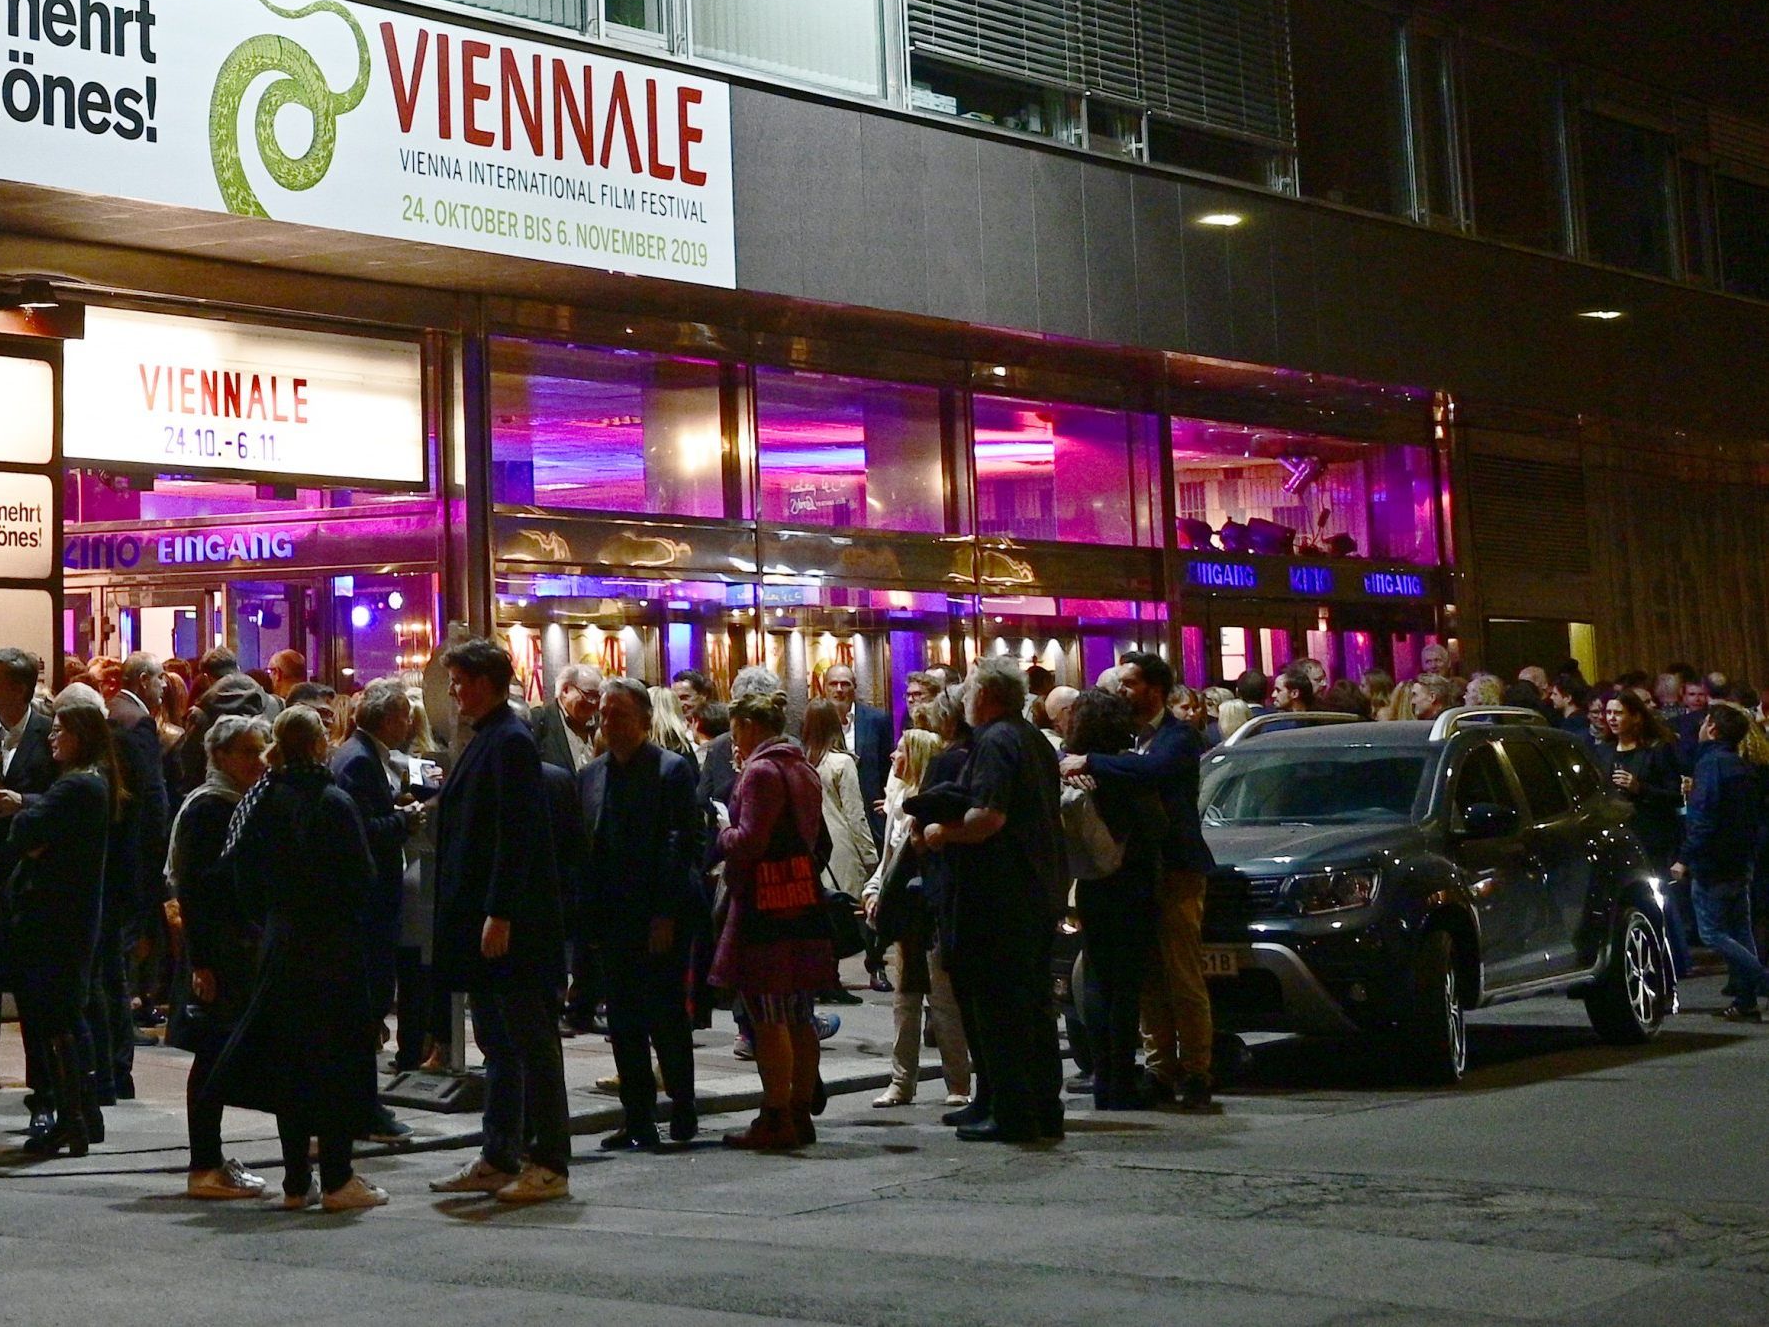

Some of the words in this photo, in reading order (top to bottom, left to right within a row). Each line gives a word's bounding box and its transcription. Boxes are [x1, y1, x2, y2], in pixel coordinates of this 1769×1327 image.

[380, 21, 707, 187] VIENNALE
[399, 148, 463, 182] VIENNA
[468, 161, 596, 204] INTERNATIONAL
[601, 184, 635, 212] FILM
[641, 191, 707, 224] FESTIVAL
[402, 194, 430, 224] 24.
[434, 200, 519, 238] OKTOBER
[524, 214, 553, 243] BIS
[557, 220, 572, 247] 6.
[575, 223, 666, 262] NOVEMBER
[671, 238, 708, 268] 2019
[139, 363, 308, 423] VIENNALE
[157, 531, 294, 564] EINGANG
